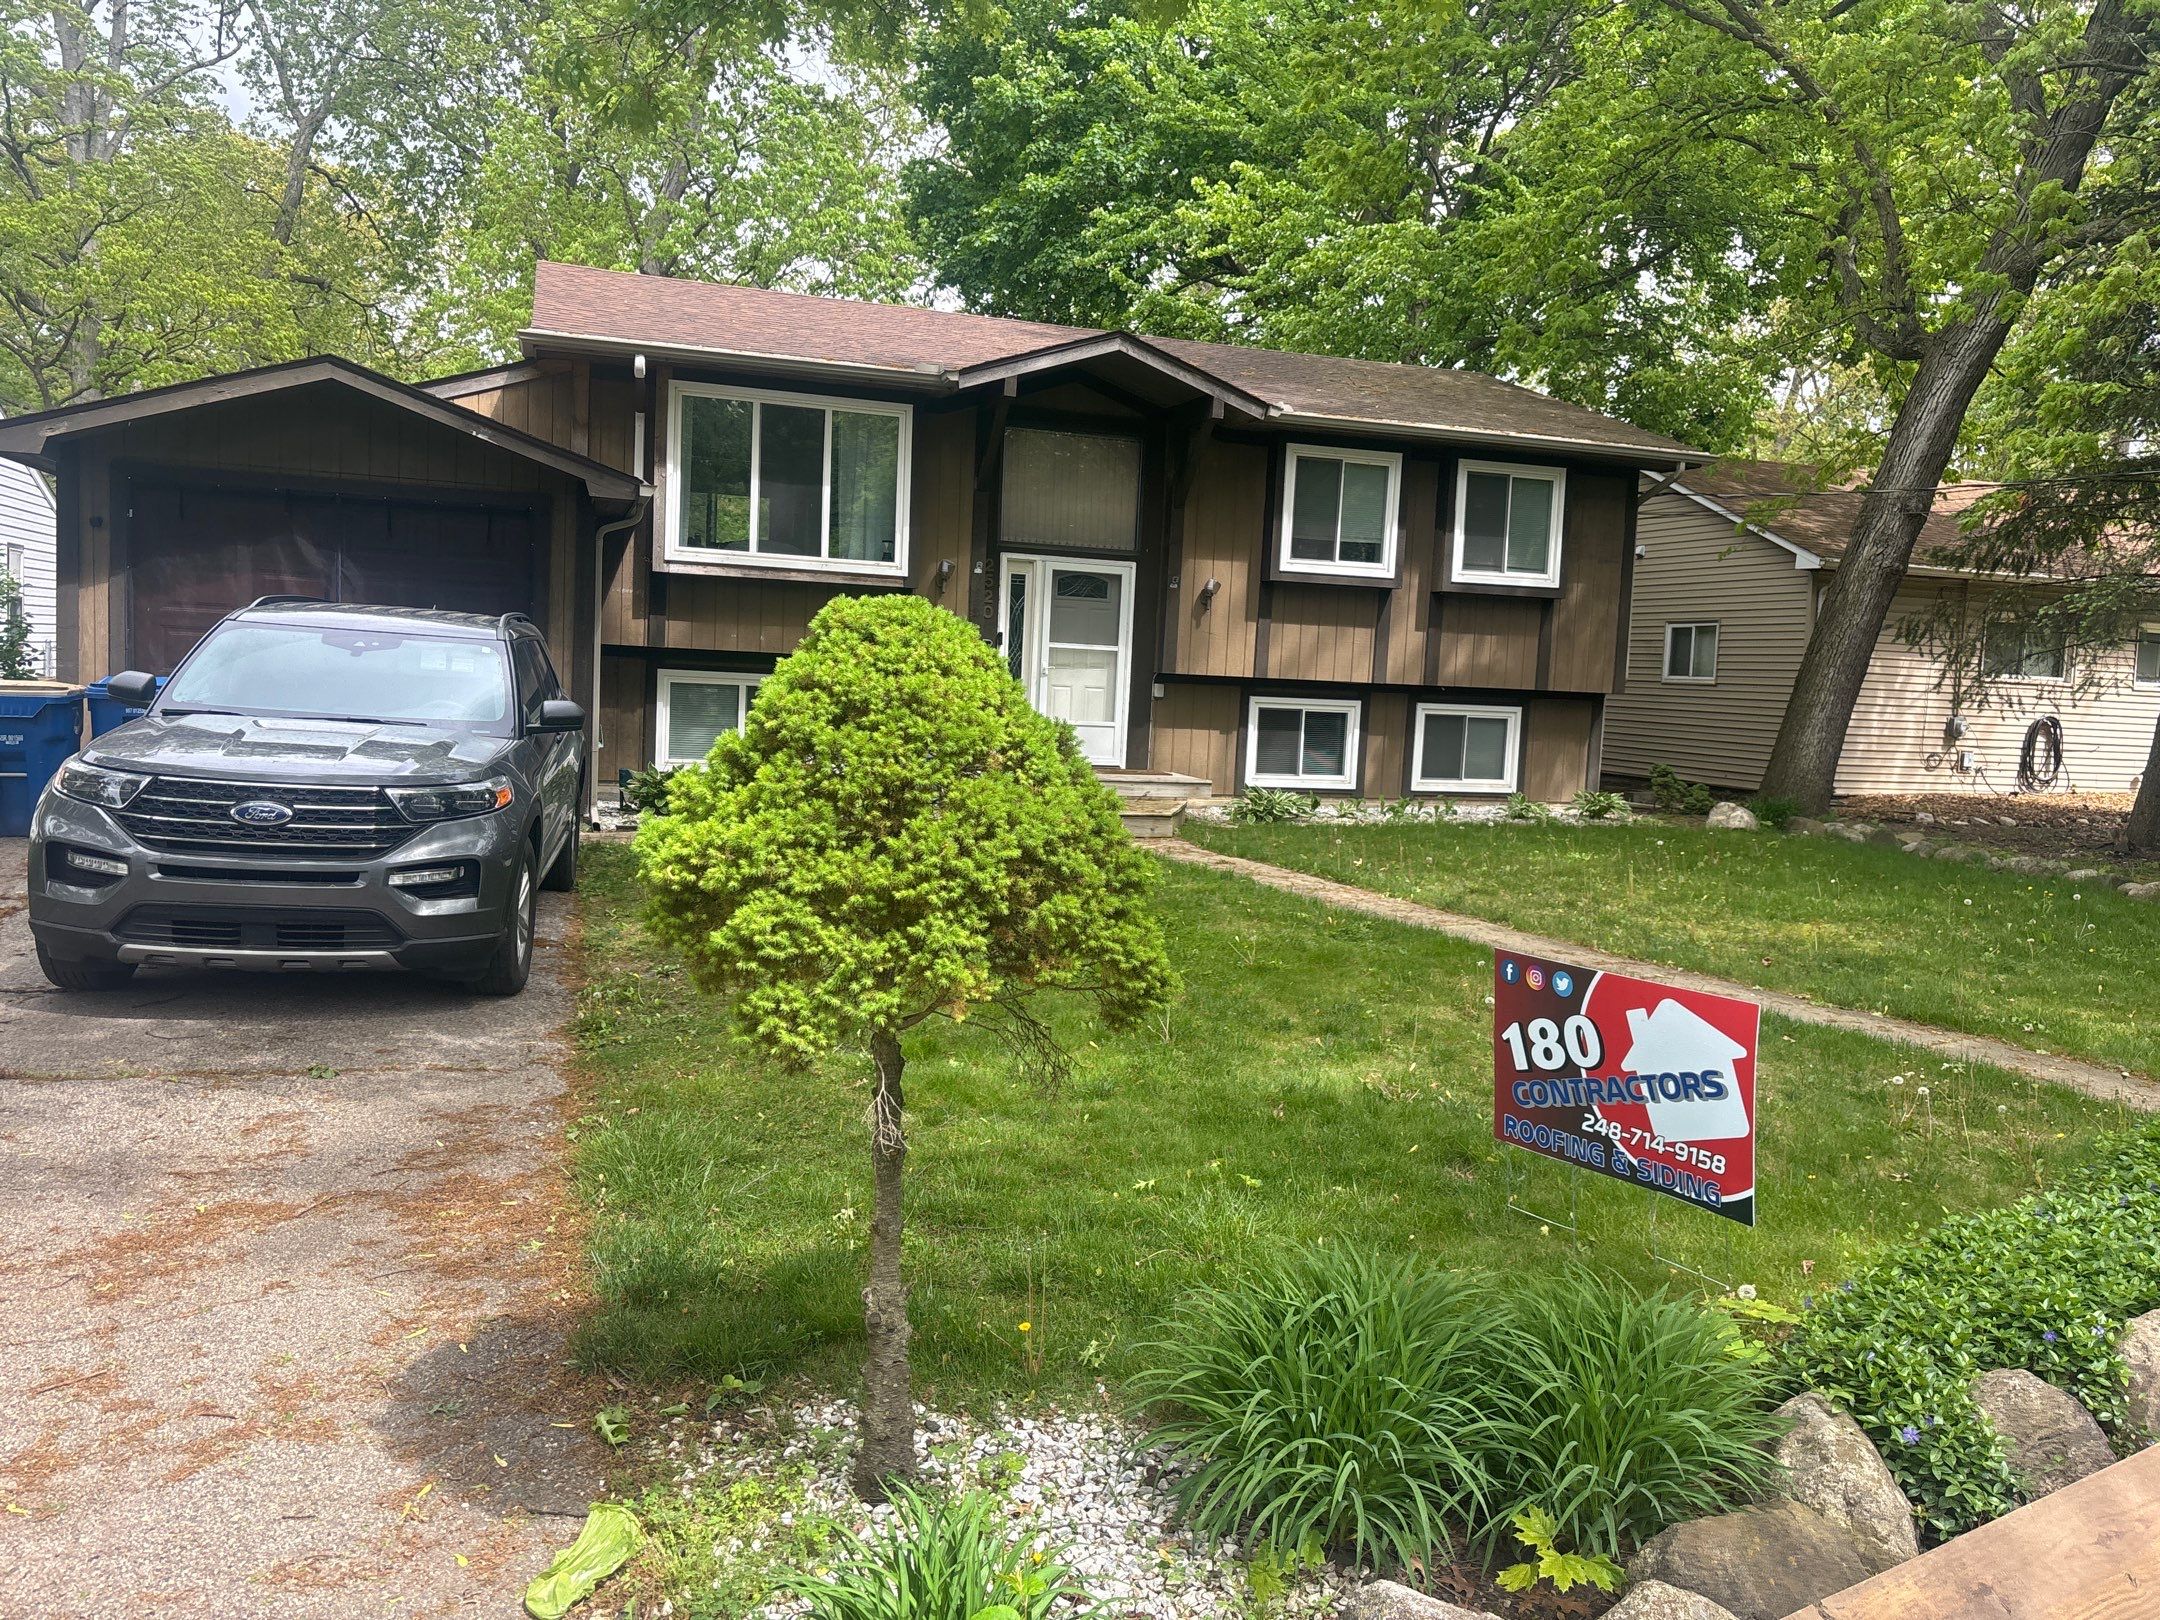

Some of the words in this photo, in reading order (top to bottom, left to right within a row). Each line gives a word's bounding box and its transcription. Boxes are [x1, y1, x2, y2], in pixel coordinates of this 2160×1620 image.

[244, 806, 280, 820] Ford
[1501, 1014, 1603, 1071] 180
[1512, 1070, 1727, 1108] CONTRACTORS
[1503, 1114, 1605, 1168] ROOFING
[1612, 1147, 1630, 1175] &
[1636, 1158, 1722, 1208] SIDING
[1581, 1113, 1727, 1174] 248-714-9158
